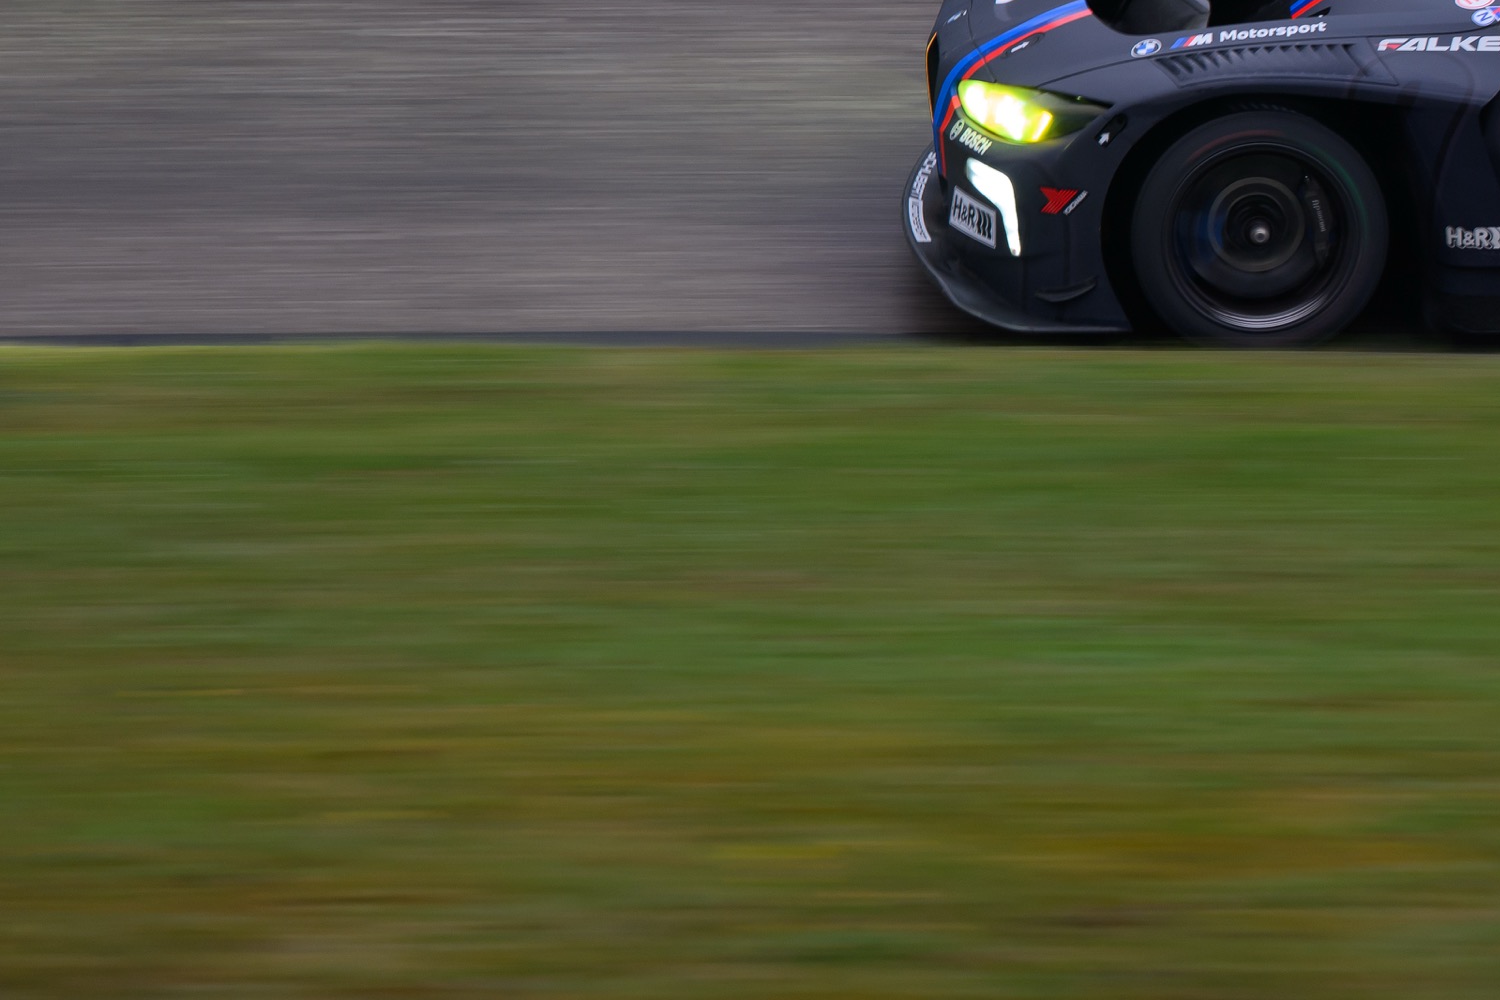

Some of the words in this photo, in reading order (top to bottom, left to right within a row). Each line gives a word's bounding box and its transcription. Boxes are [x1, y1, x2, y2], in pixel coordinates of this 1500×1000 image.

[1477, 11, 1493, 22] N
[1220, 21, 1327, 43] Motorsport
[958, 127, 993, 156] BOSCH
[1445, 226, 1493, 250] H&R
